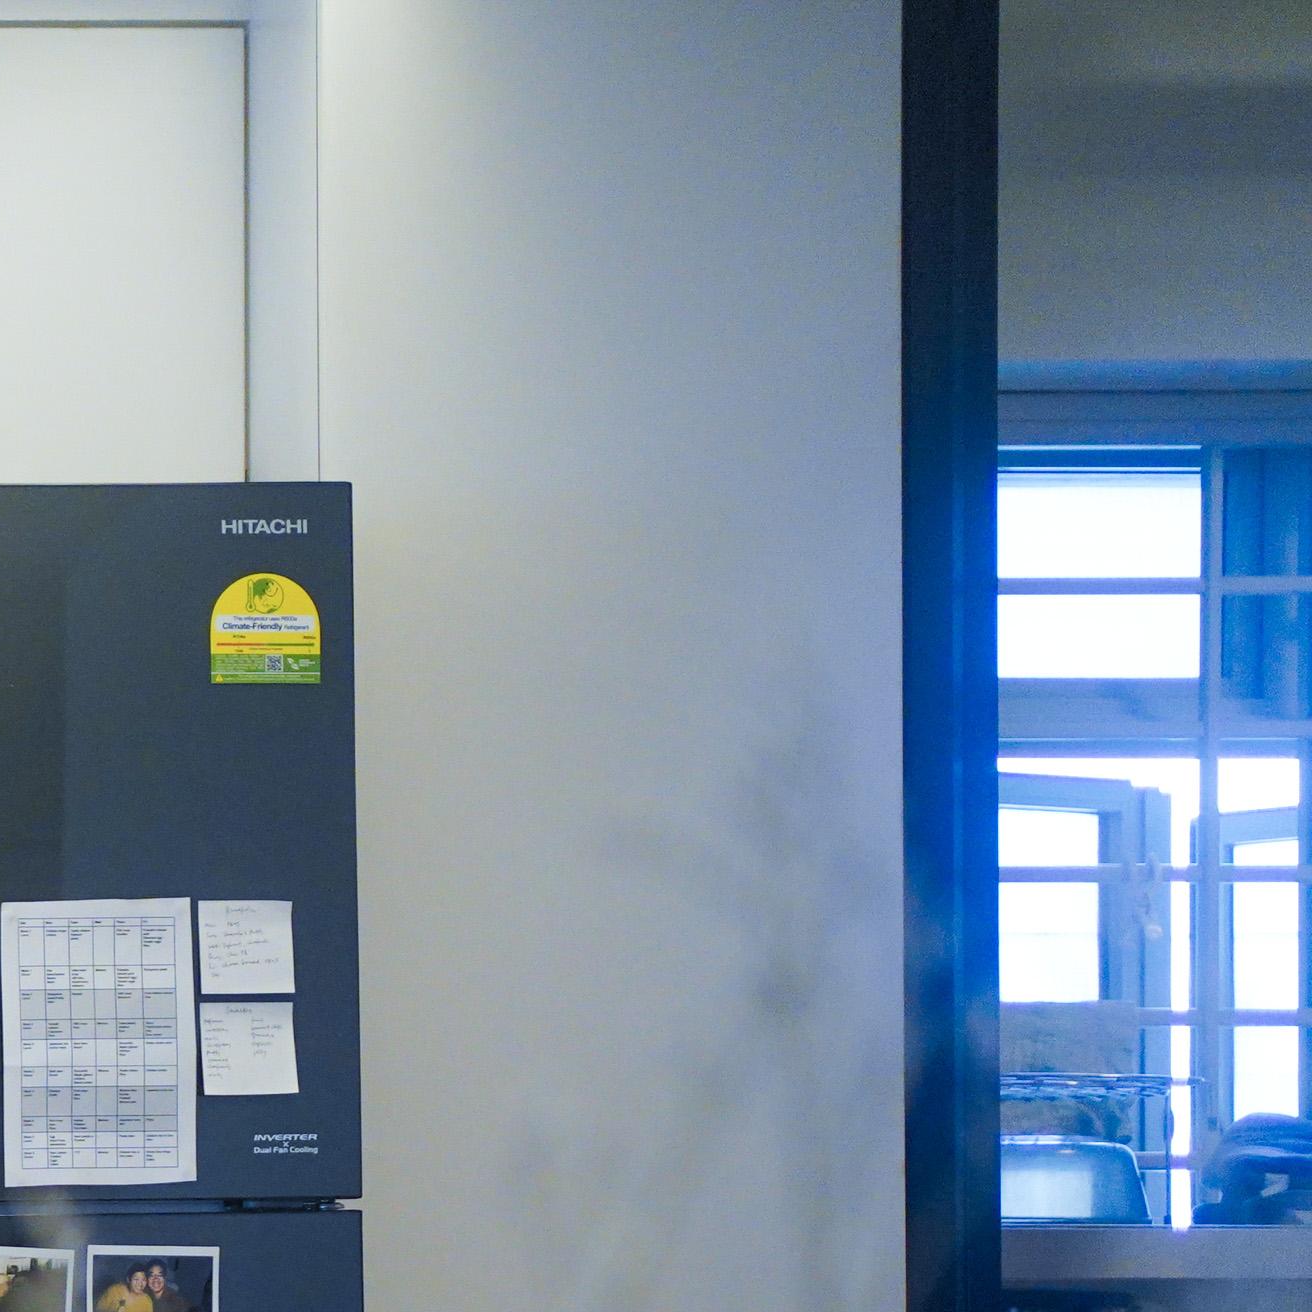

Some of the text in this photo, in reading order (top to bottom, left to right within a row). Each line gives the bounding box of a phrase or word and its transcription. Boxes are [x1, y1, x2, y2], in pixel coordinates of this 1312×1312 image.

[221, 519, 308, 534] HITACHI
[222, 622, 282, 632] Climate-Friendly
[253, 1133, 318, 1141] INVERTER
[289, 1146, 319, 1154] Cooling
